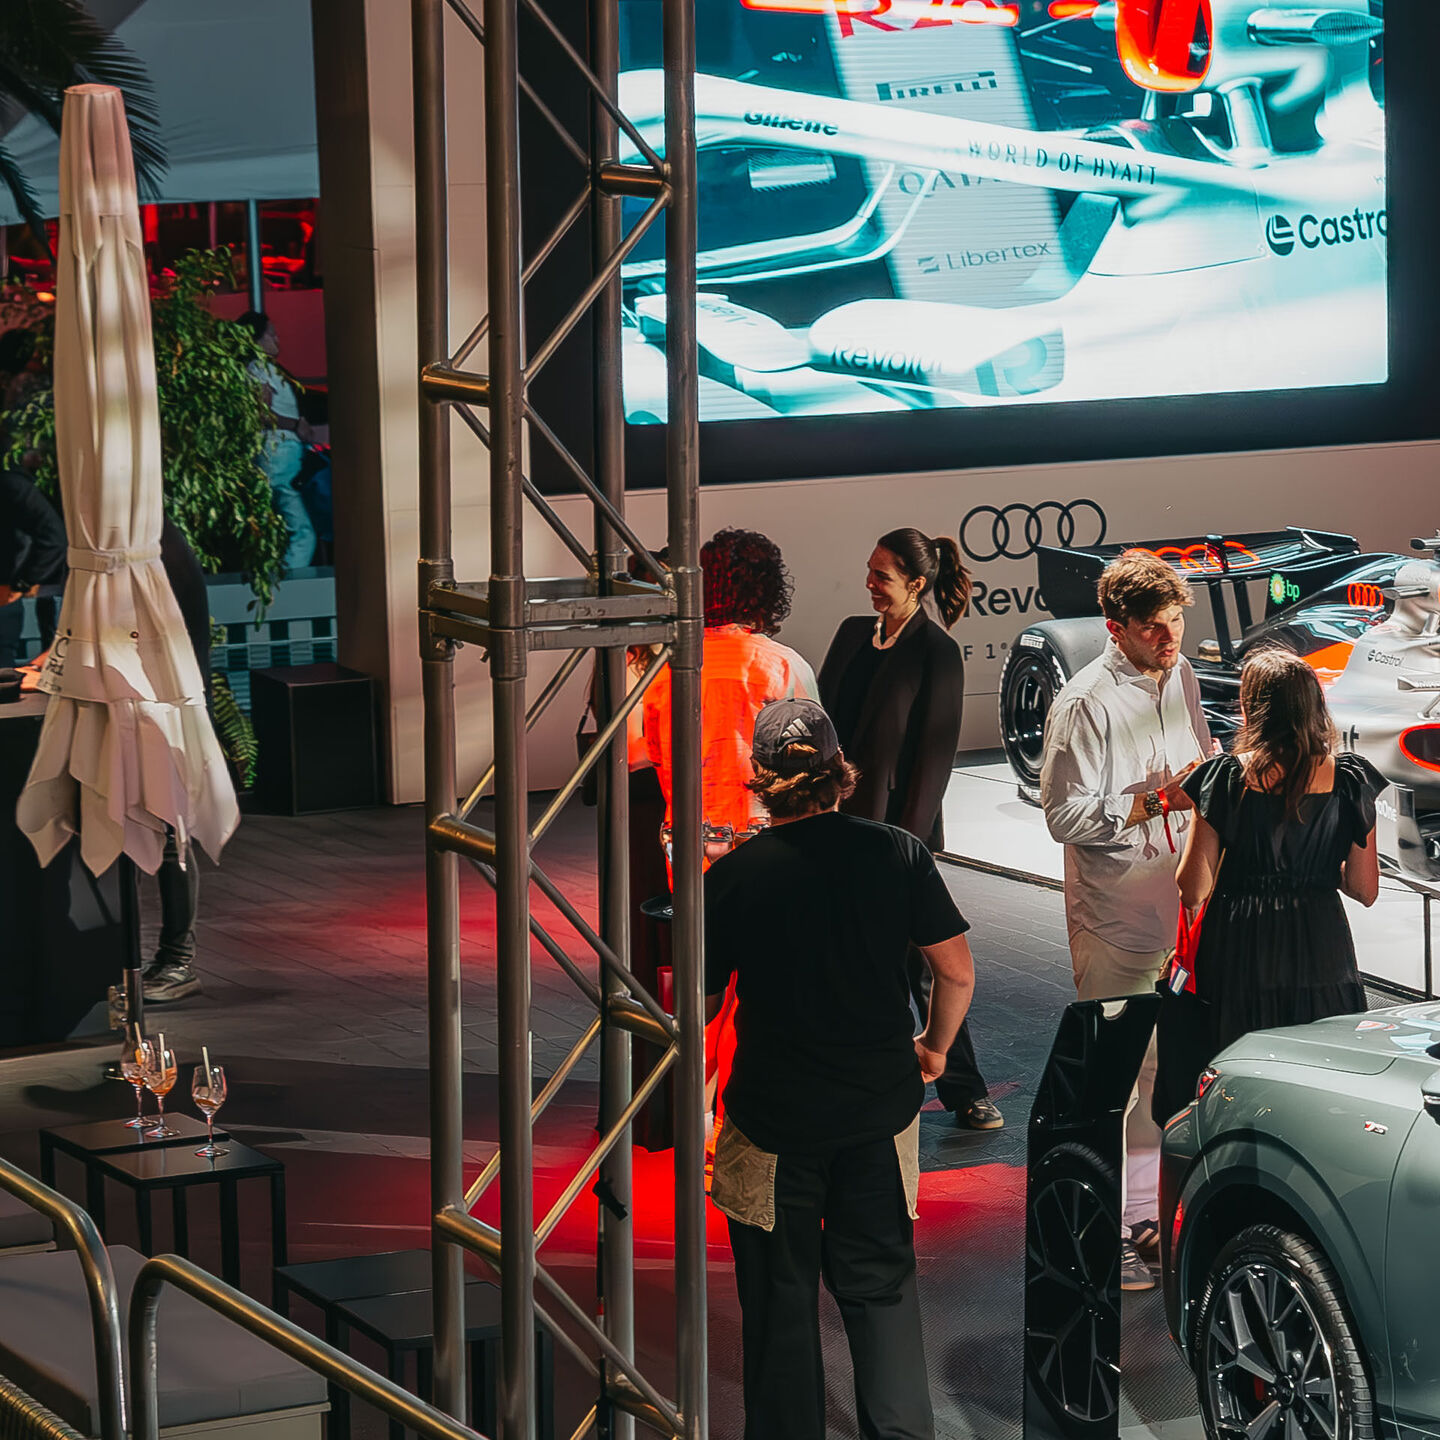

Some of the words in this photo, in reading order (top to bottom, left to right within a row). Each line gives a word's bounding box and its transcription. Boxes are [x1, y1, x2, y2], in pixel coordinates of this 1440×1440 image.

[876, 70, 998, 101] PIRELLI
[968, 138, 1048, 168] WORLD
[1058, 152, 1084, 174] OF
[1092, 157, 1157, 185] HYATT
[946, 242, 1052, 271] Libertex
[1286, 579, 1301, 602] bp
